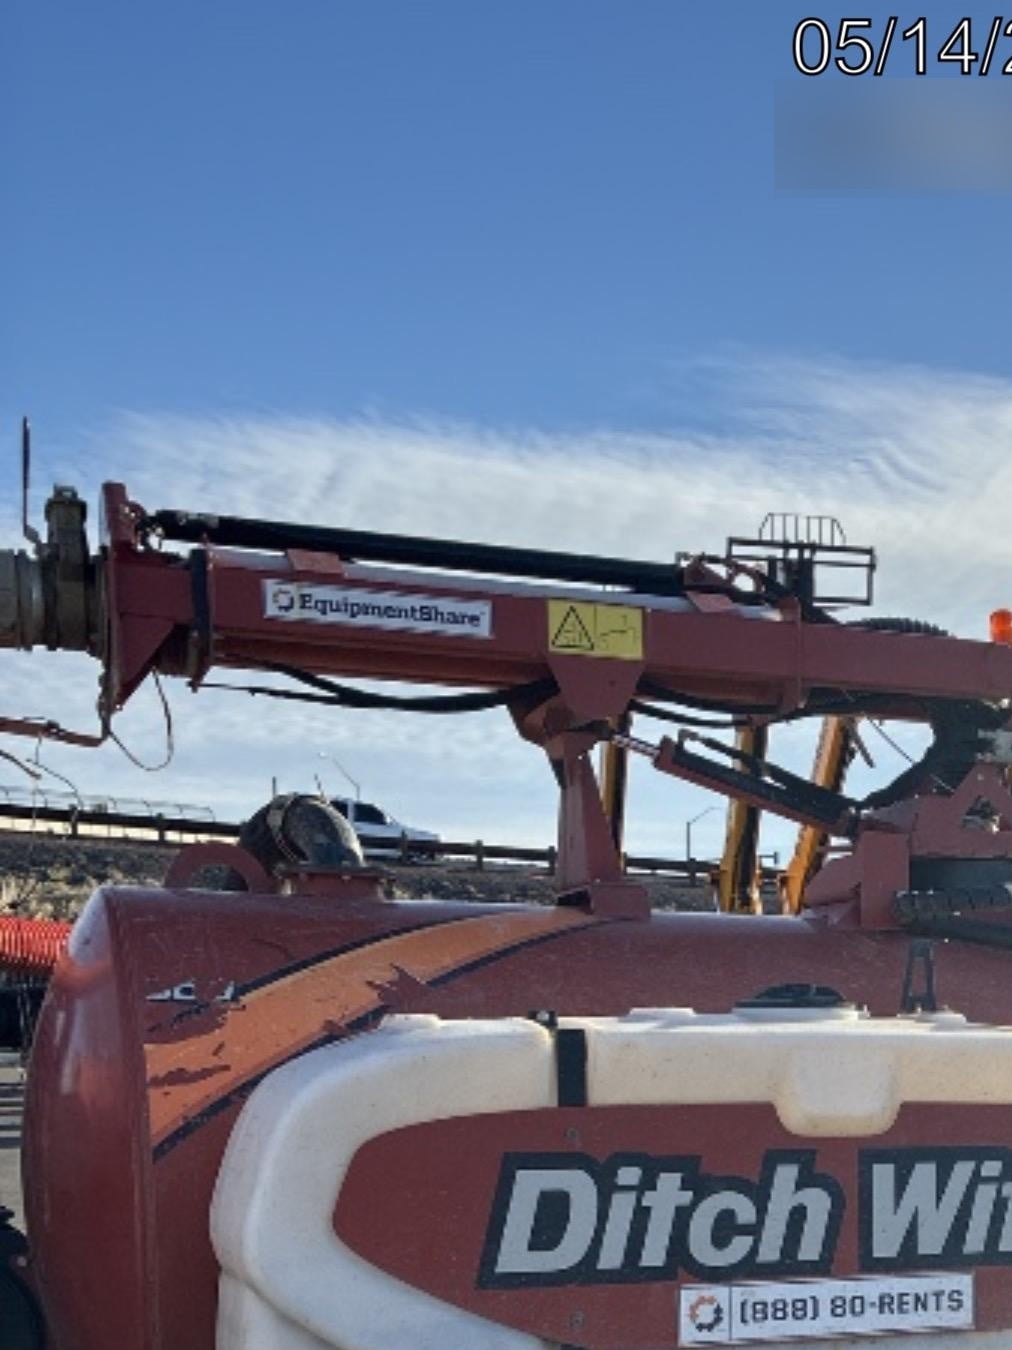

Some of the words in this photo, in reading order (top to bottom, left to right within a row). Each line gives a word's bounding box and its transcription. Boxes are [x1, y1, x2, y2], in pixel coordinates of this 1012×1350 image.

[299, 592, 482, 628] EquipmentShare
[494, 1162, 834, 1273] Ditch
[740, 1295, 820, 1324] (888)
[829, 1289, 964, 1318] 80-RENTS
